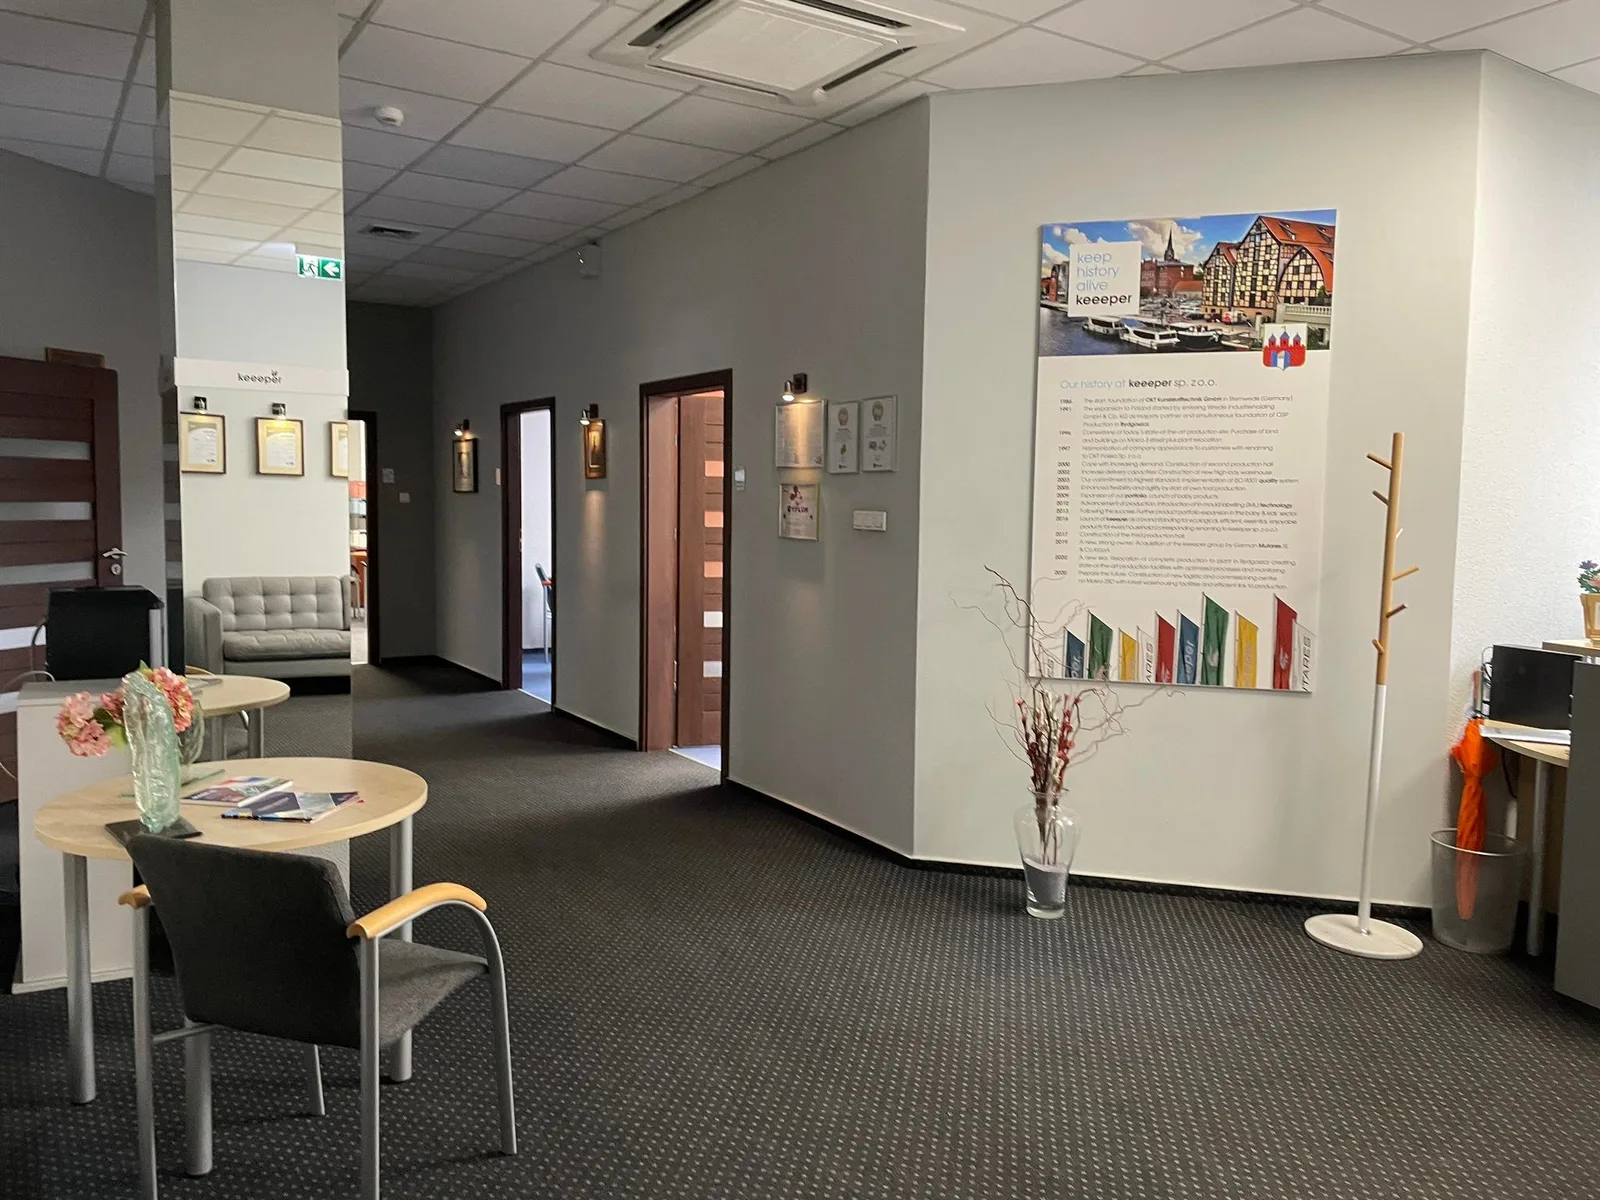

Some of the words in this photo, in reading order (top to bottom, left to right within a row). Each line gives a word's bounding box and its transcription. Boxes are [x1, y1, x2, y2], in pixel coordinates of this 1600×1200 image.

[1077, 252, 1112, 264] keep
[1077, 266, 1119, 278] history
[1076, 280, 1108, 292] alive
[1076, 294, 1132, 306] keeeper
[237, 372, 282, 384] keeeper
[1060, 380, 1078, 390] Our
[1080, 379, 1112, 390] history
[1114, 380, 1126, 388] at
[1128, 378, 1172, 390] keeeper
